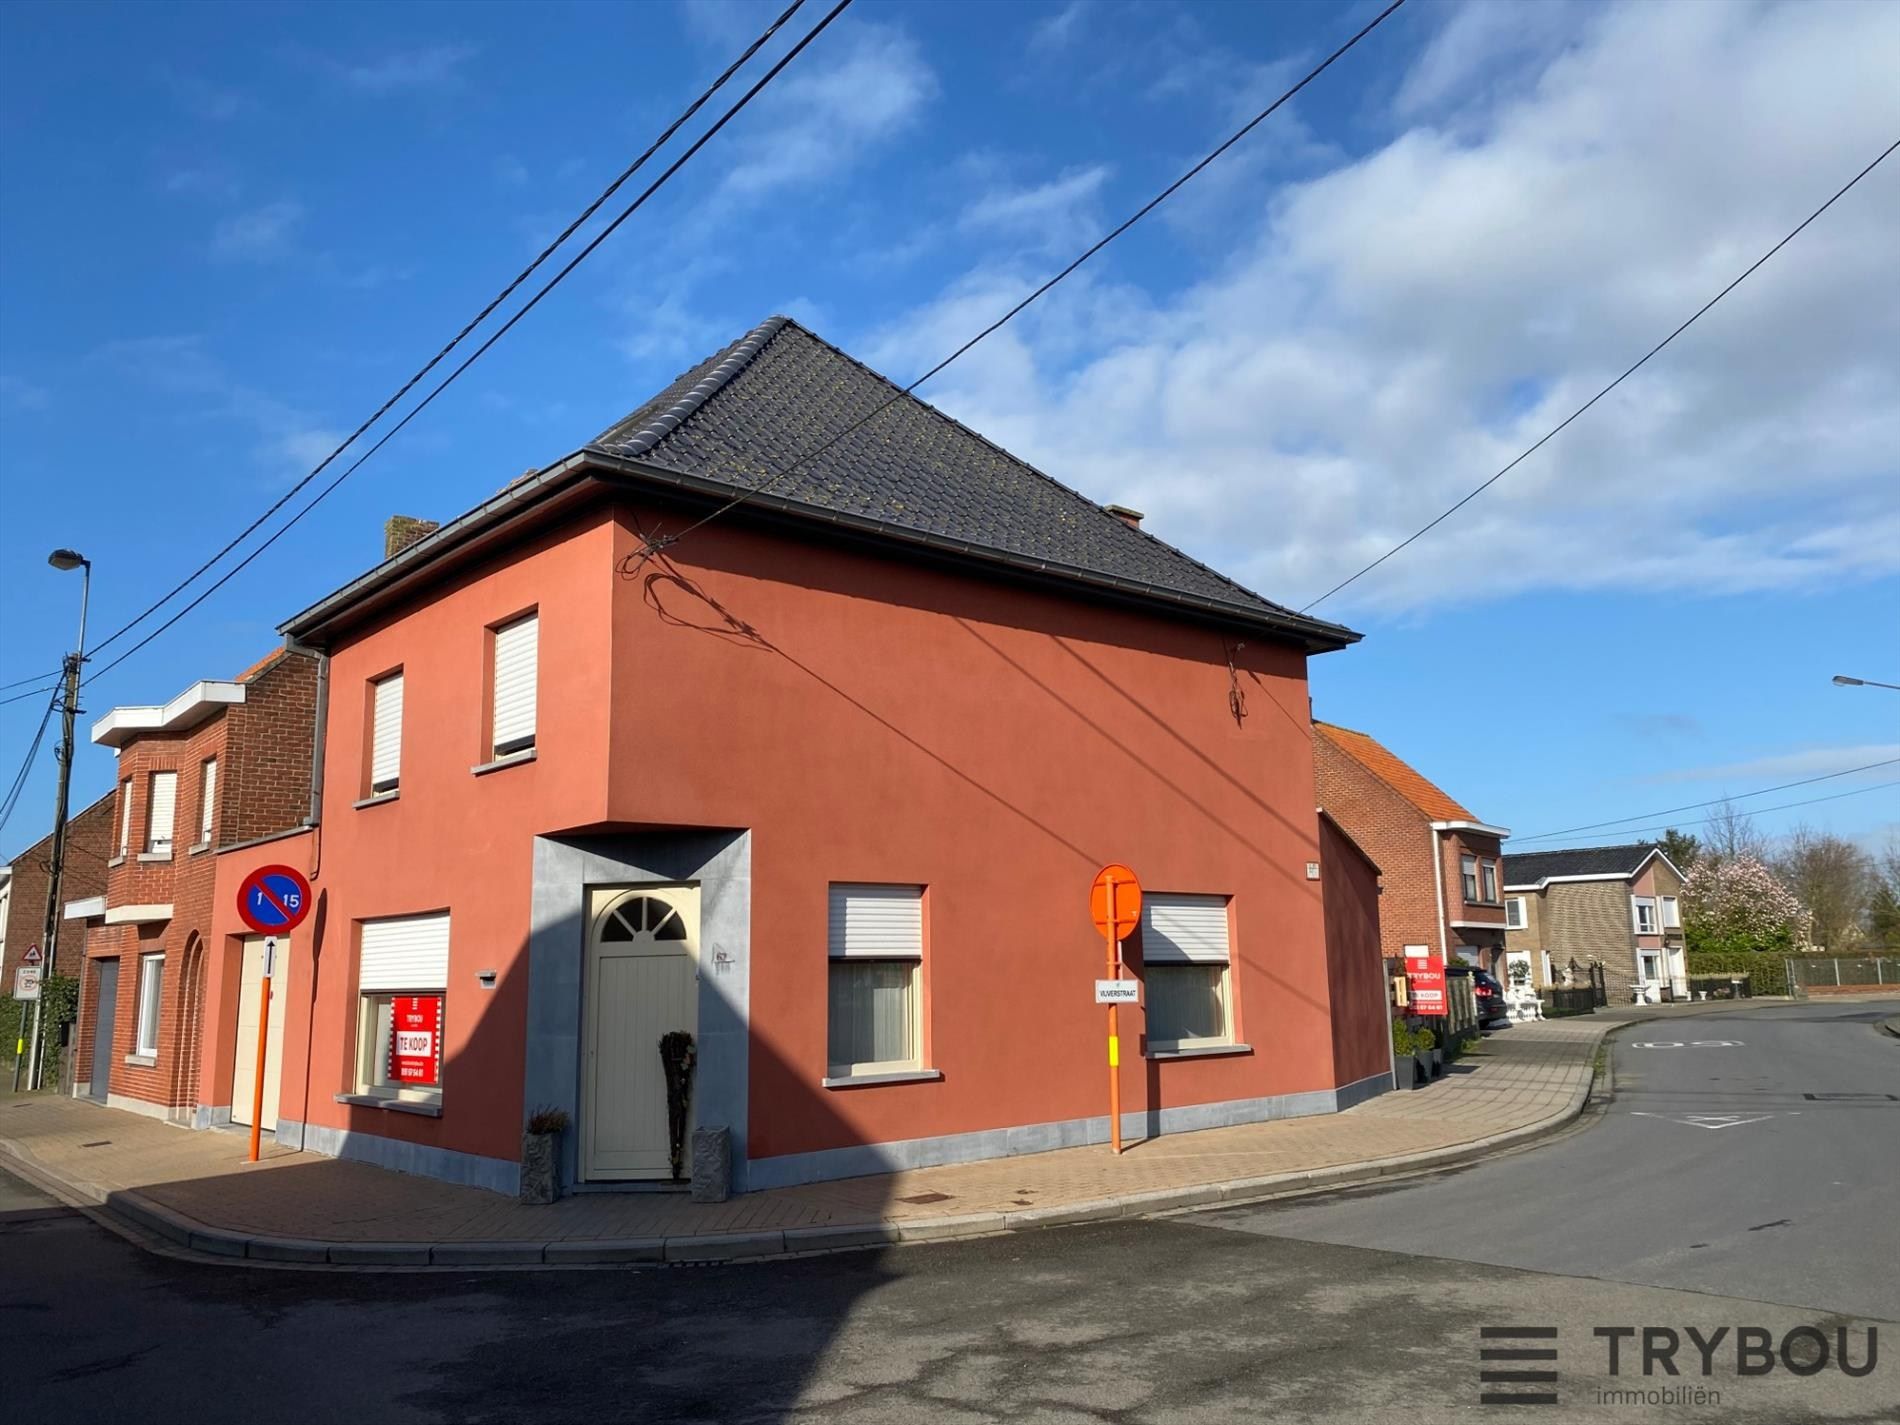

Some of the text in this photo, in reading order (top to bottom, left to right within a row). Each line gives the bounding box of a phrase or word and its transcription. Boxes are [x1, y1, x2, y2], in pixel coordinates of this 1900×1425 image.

[257, 892, 262, 905] 1
[283, 894, 300, 908] 15
[400, 1037, 428, 1051] TE KOOP
